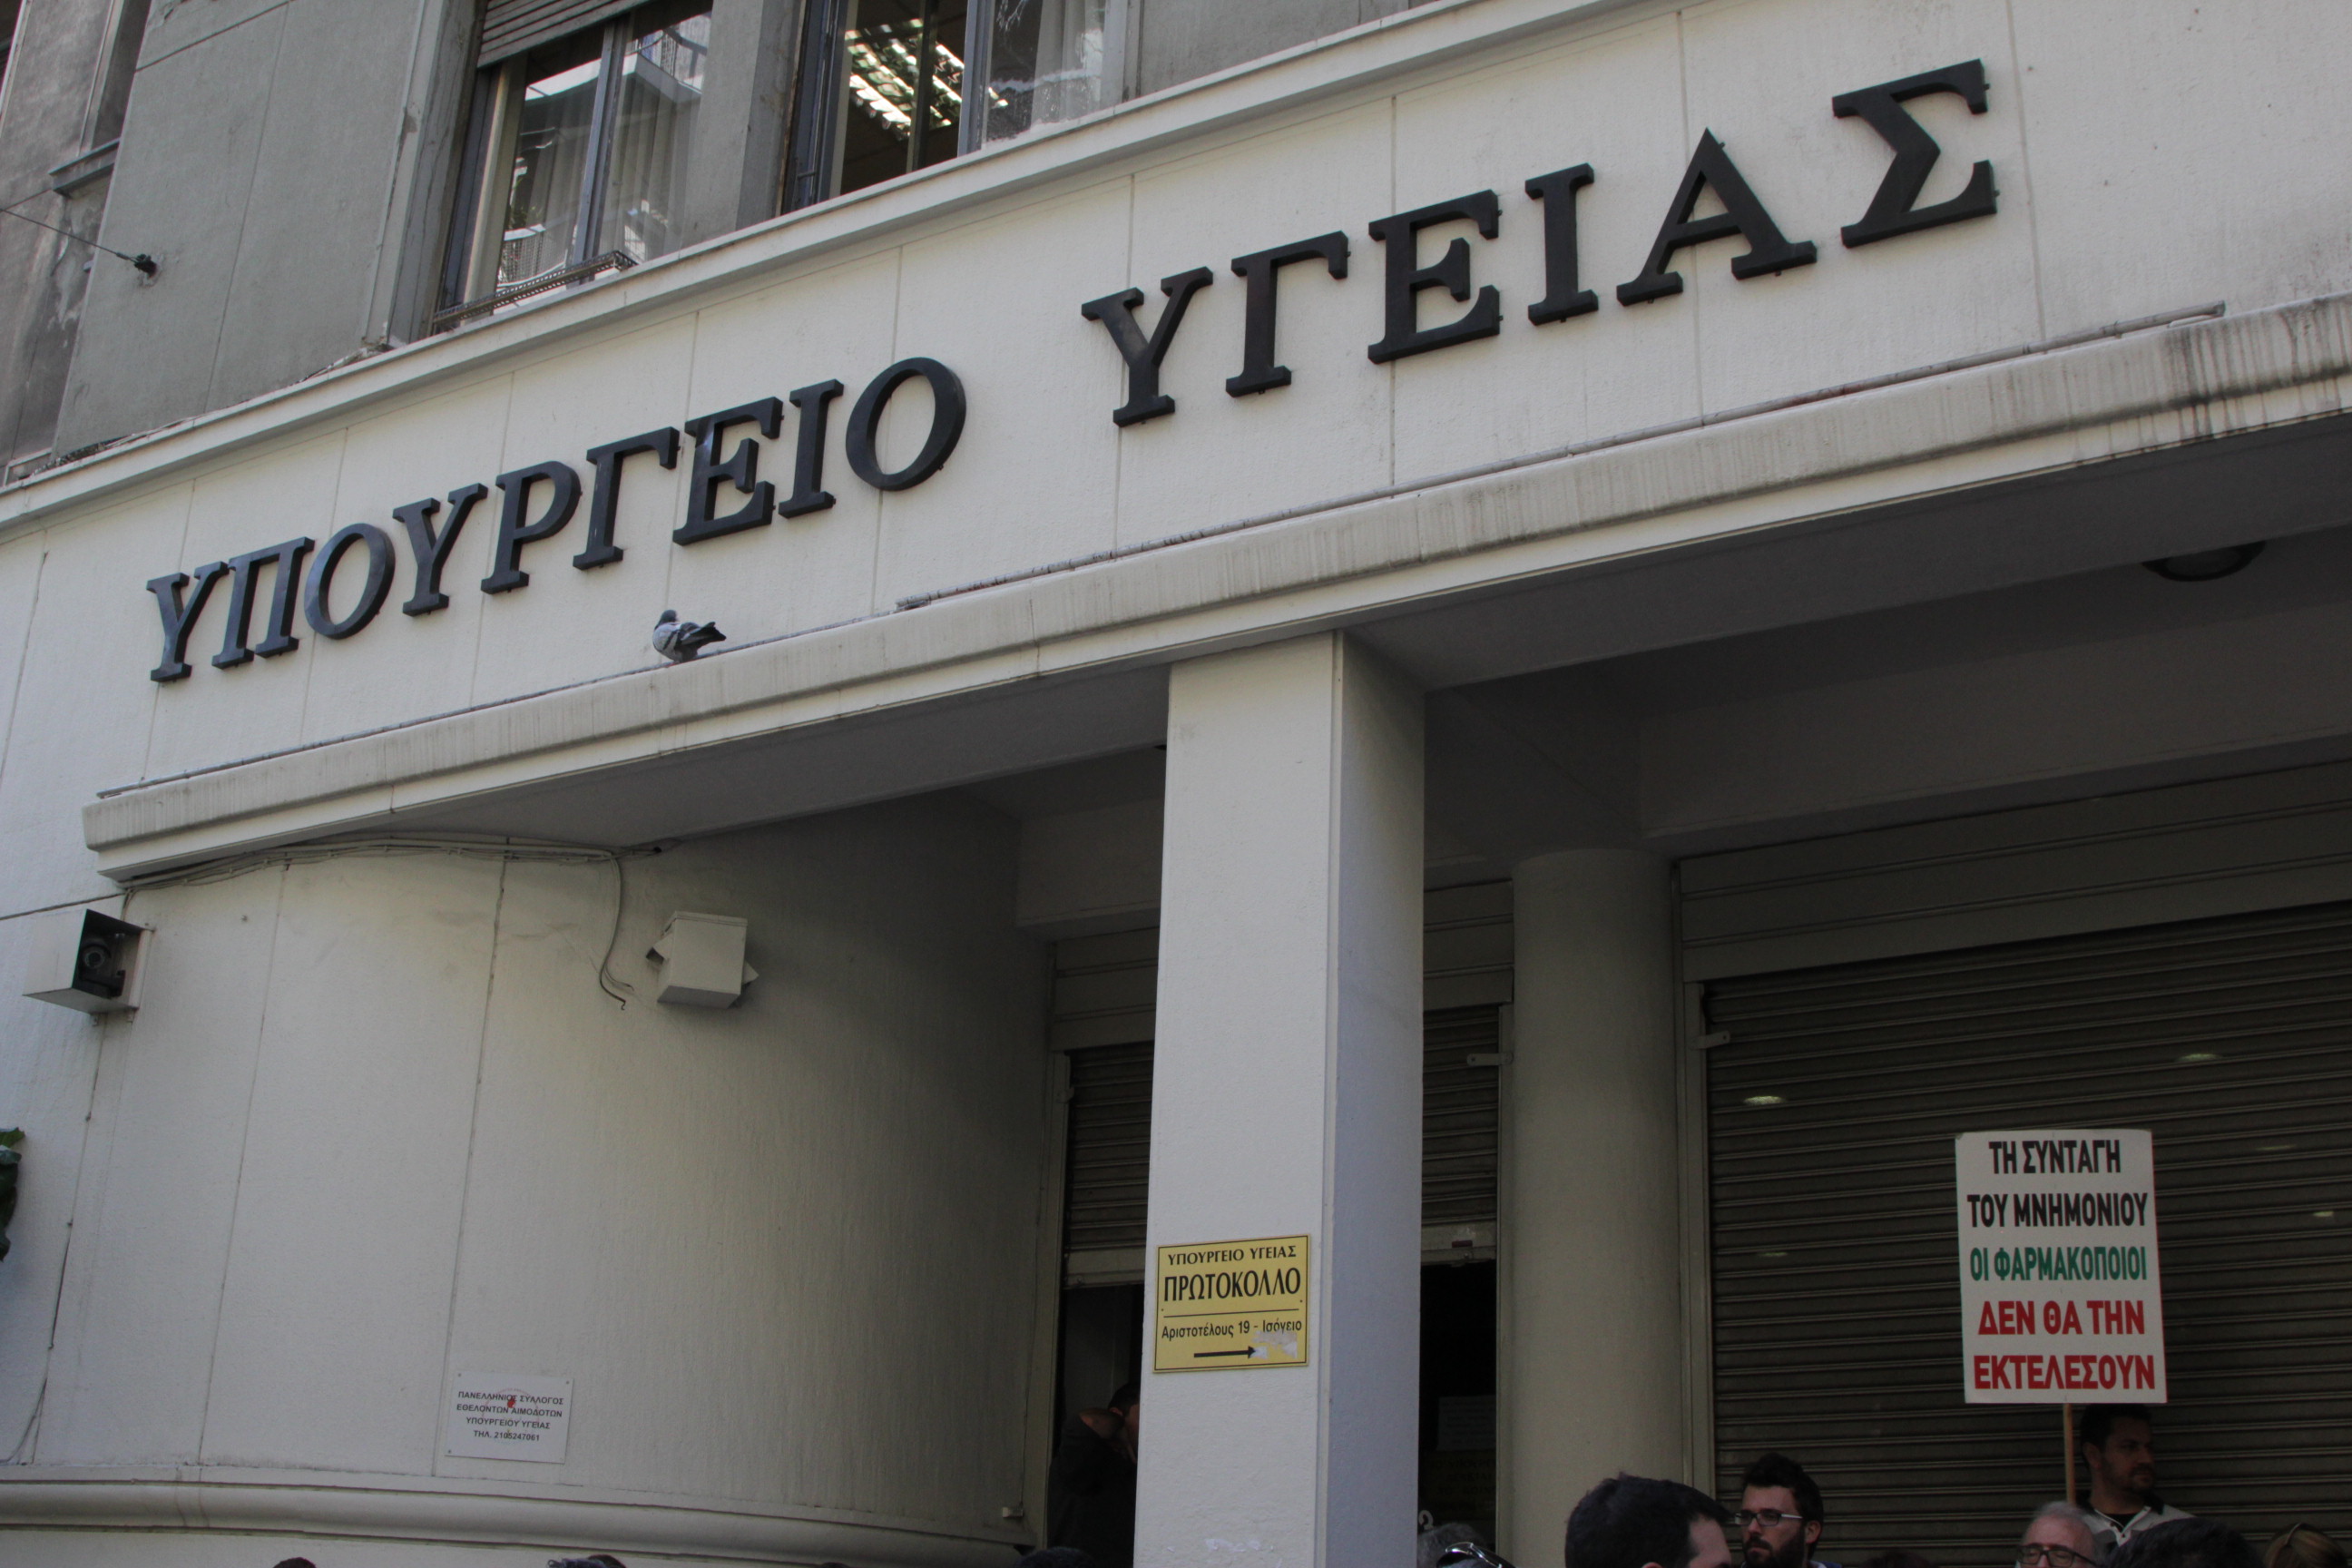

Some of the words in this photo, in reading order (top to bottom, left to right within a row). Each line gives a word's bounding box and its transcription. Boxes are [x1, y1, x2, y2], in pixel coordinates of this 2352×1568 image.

[146, 357, 967, 683] ΥΠΟΥΡΓΕΙΟ
[1081, 58, 1999, 428] ΥΓΕΙΑΣ
[1988, 1140, 2017, 1174] ΤΗ
[2022, 1140, 2122, 1174] ΣΥΝΤΑΓΗ
[1966, 1193, 2008, 1228] ΤΟΥ
[2014, 1192, 2148, 1228] ΜΝΗΜΟΝΙΟΥ
[1168, 1249, 1244, 1266] ΥΠΟΥΡΓΕΙΟ
[1250, 1245, 1297, 1259] ΥΓΕΙΑΣ
[1970, 1247, 1989, 1281] ΟΙ
[1994, 1246, 2148, 1280] ΦΑΡΜΑΚΟΠΟΙΟΙ
[1164, 1267, 1301, 1301] ΠΡΩΤΟΚΟΛΛΟ
[1161, 1322, 1234, 1341] Αριστοτέλους
[1239, 1320, 1250, 1334] 19
[1262, 1318, 1302, 1334] Ισόγειο
[1978, 1300, 2035, 1335] ΔΕΝ
[2043, 1300, 2083, 1335] ΘΑ
[2086, 1300, 2145, 1335] ΤΗΝ
[1974, 1355, 2156, 1389] ΕΚΤΕΛΕΣΟΥΝ
[456, 1404, 508, 1413] ΕΘΕΛΟΝΤΩΝ
[511, 1408, 563, 1417] ΑΙΜΟΔΟΤΩΝ
[458, 1391, 517, 1402] ΠΑΝΕΛΛΗΝΙΟΣ
[520, 1395, 564, 1405] ΣΥΛΛΟΓΟΣ
[466, 1417, 520, 1427] ΥΠΟΥΡΓΕΙΟΥ
[522, 1421, 550, 1429] ΥΓΕΙΑΣ
[474, 1430, 492, 1438] ΤΗΛ.
[494, 1431, 540, 1441] 2105247061
